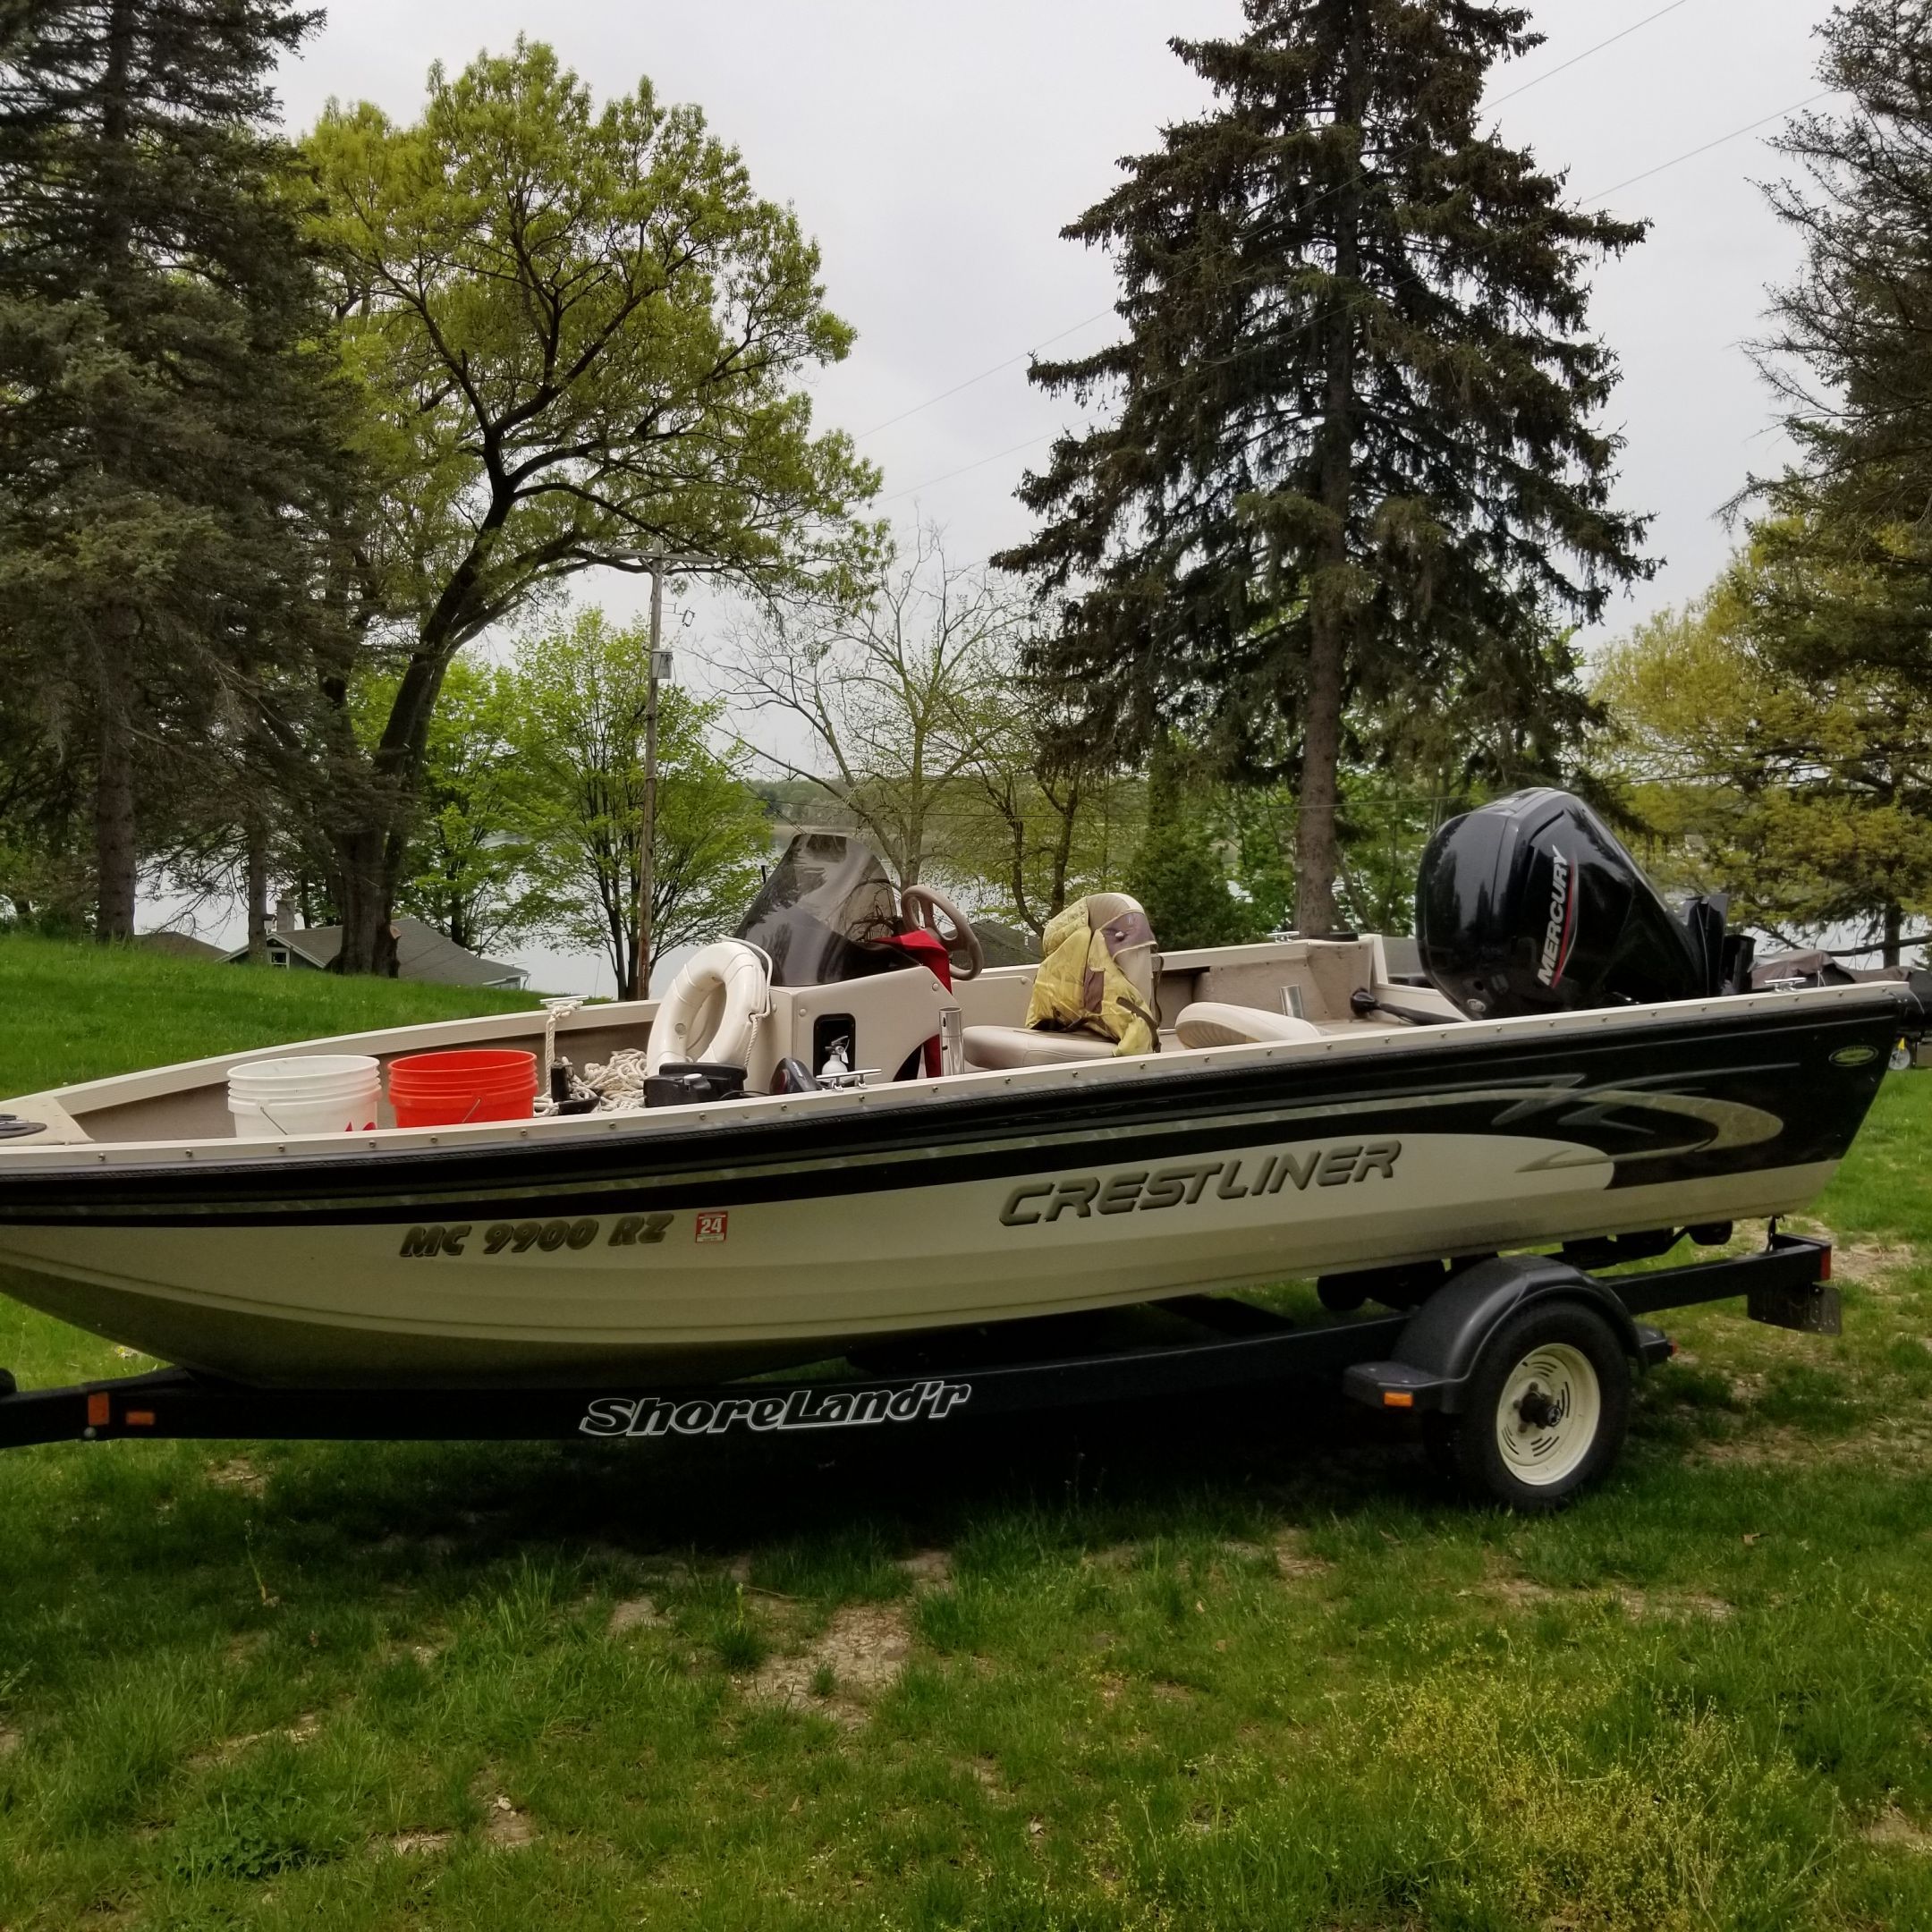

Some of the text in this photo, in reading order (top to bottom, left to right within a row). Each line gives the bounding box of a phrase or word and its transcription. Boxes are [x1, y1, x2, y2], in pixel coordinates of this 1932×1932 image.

[1538, 844, 1568, 986] MERCURY
[999, 1140, 1402, 1226] CRESTLINER
[399, 1213, 674, 1257] MC 9900 RZ
[700, 1217, 722, 1233] 24
